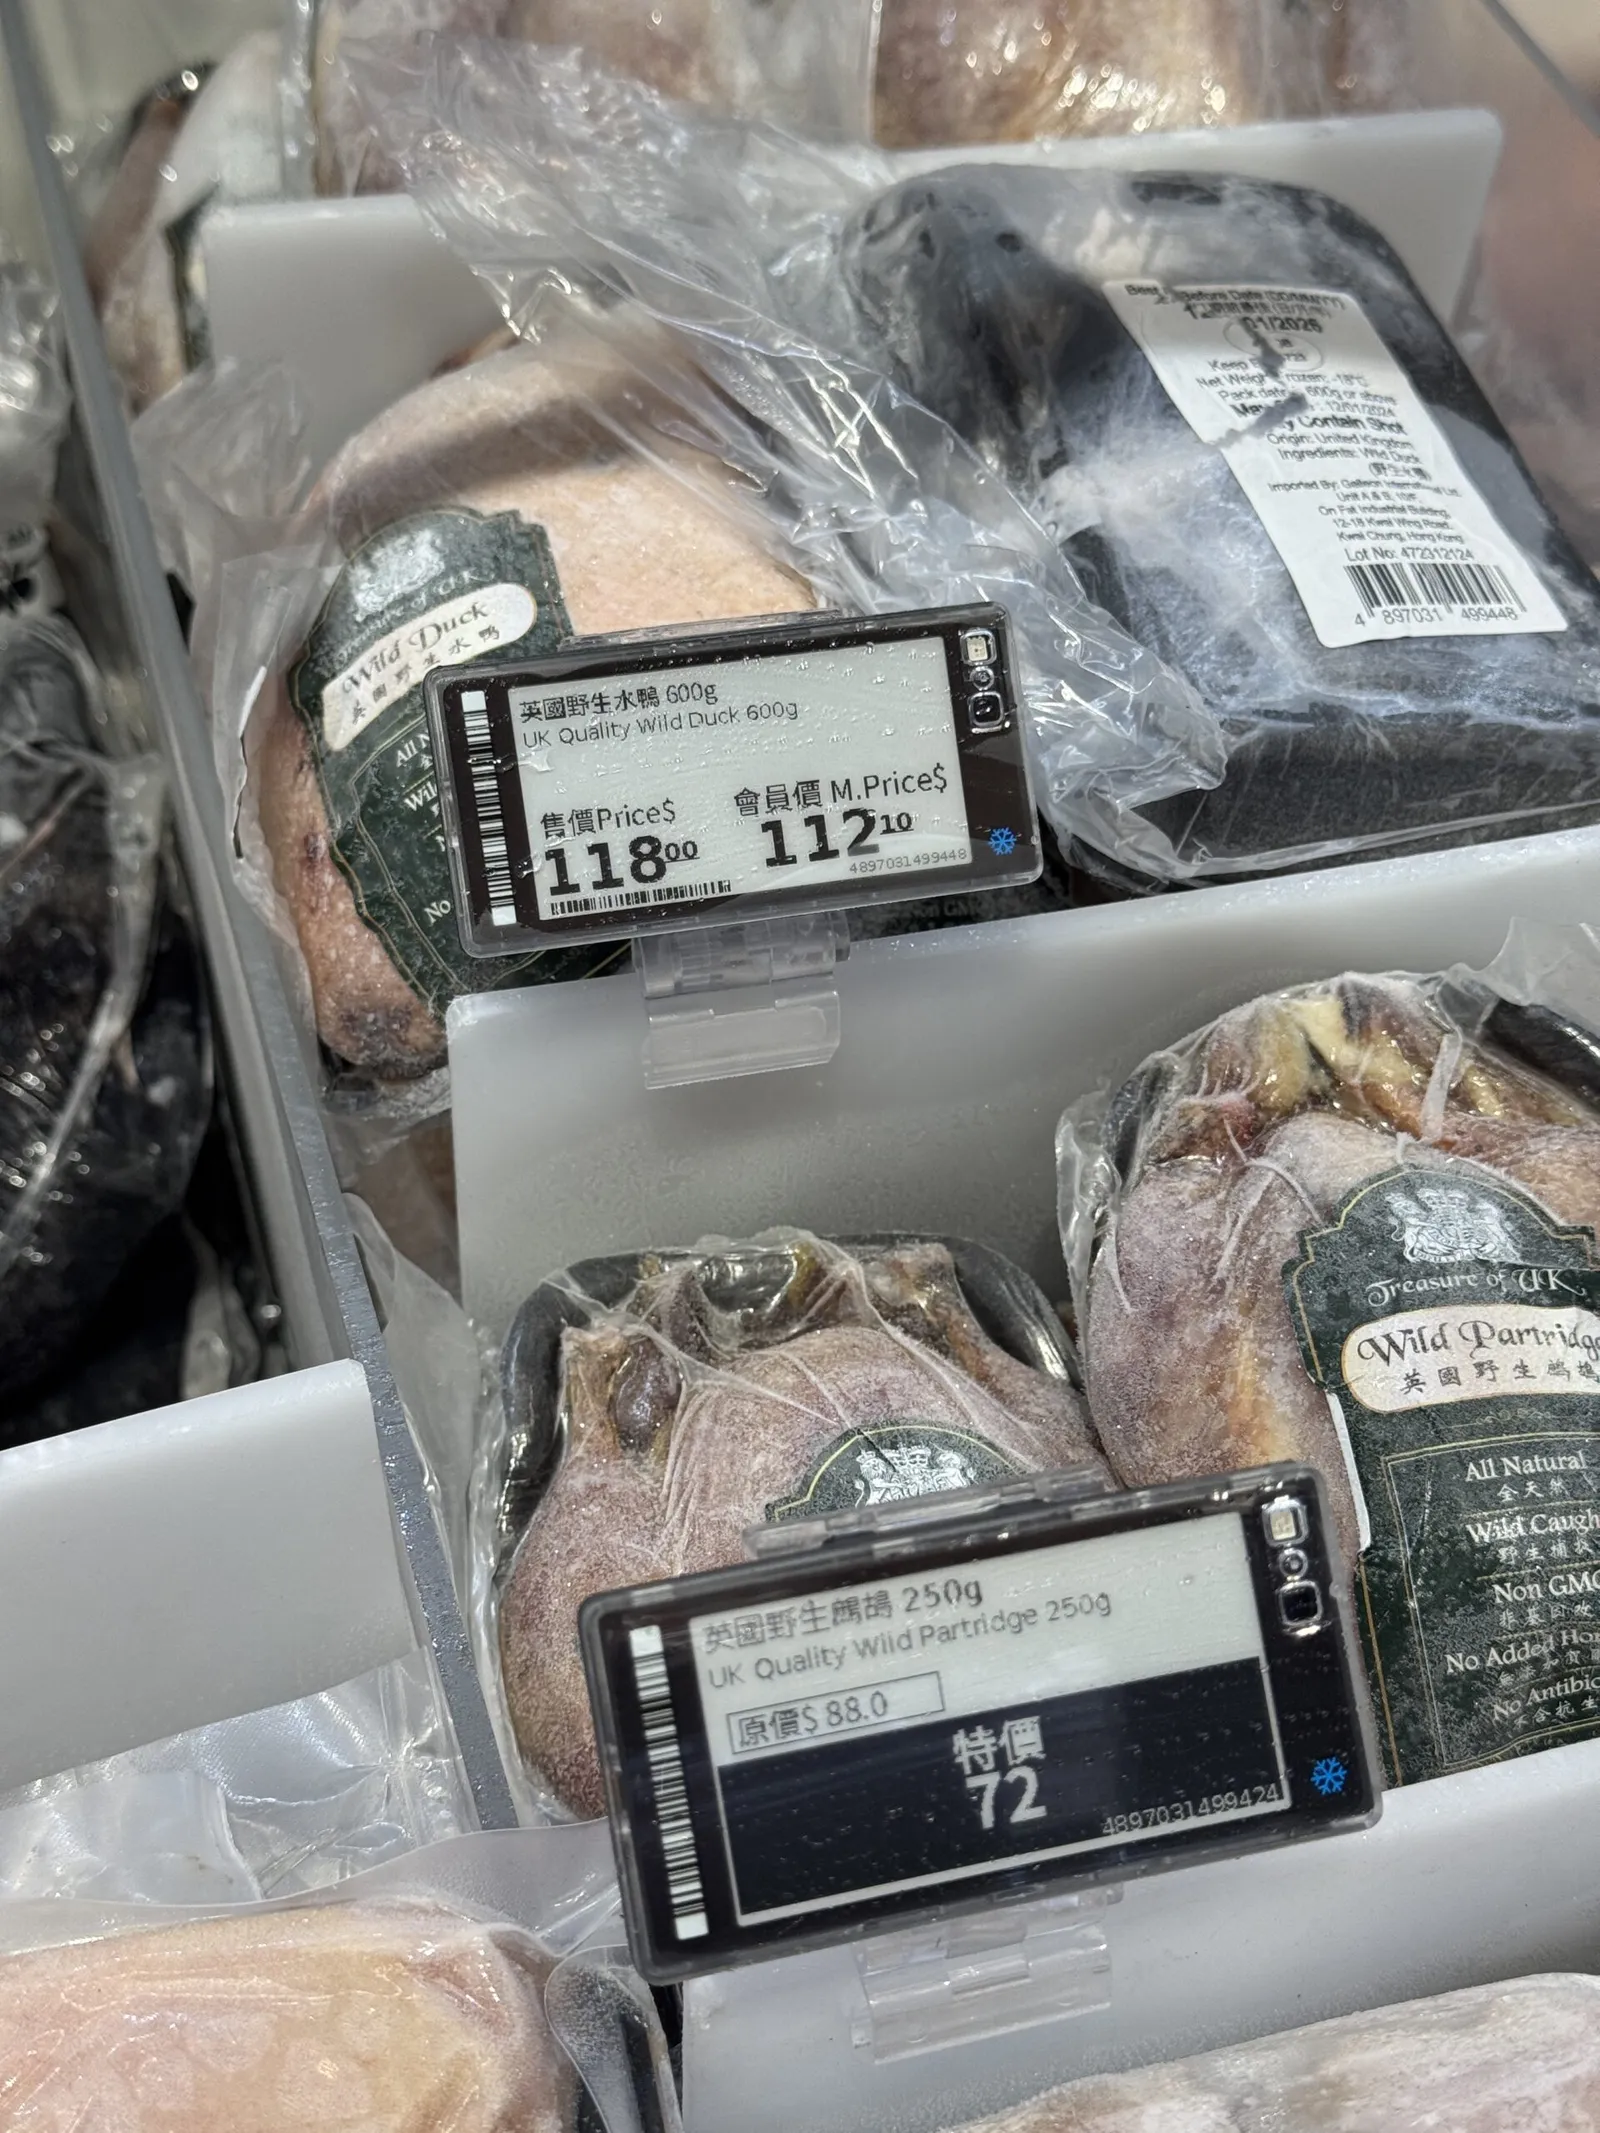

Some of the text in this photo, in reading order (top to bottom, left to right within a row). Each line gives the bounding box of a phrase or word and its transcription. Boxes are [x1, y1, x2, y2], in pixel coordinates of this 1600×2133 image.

[1299, 415, 1366, 430] Contain
[1314, 432, 1361, 446] United
[1344, 547, 1371, 562] Lot
[1355, 606, 1519, 628] 4 897031 499448
[341, 601, 491, 695] Wild Duck
[518, 682, 719, 724] 英國野生水鴨 600g
[522, 701, 799, 749] UK Quality Wild Duck 600g
[396, 740, 418, 768] All
[403, 781, 438, 813] Wil
[733, 762, 948, 818] 會員價 M.Price$
[849, 847, 969, 875] 4897031499448
[1366, 1267, 1587, 1308] Treasure of UK
[1356, 1321, 1453, 1368] Wild
[1464, 1450, 1588, 1483] All Natural
[1465, 1515, 1527, 1544] Wild
[901, 1578, 983, 1613] 250g
[1491, 1581, 1545, 1605] Non
[708, 1591, 1113, 1690] UK Quality Wild Partridge 250g
[1444, 1652, 1480, 1675] No
[1486, 1634, 1555, 1668] Added
[825, 1690, 889, 1728] 88.0
[1493, 1699, 1522, 1722] No
[952, 1715, 1047, 1777] 特價
[965, 1764, 1049, 1830] 72
[1102, 1781, 1280, 1837] 4897031499424
